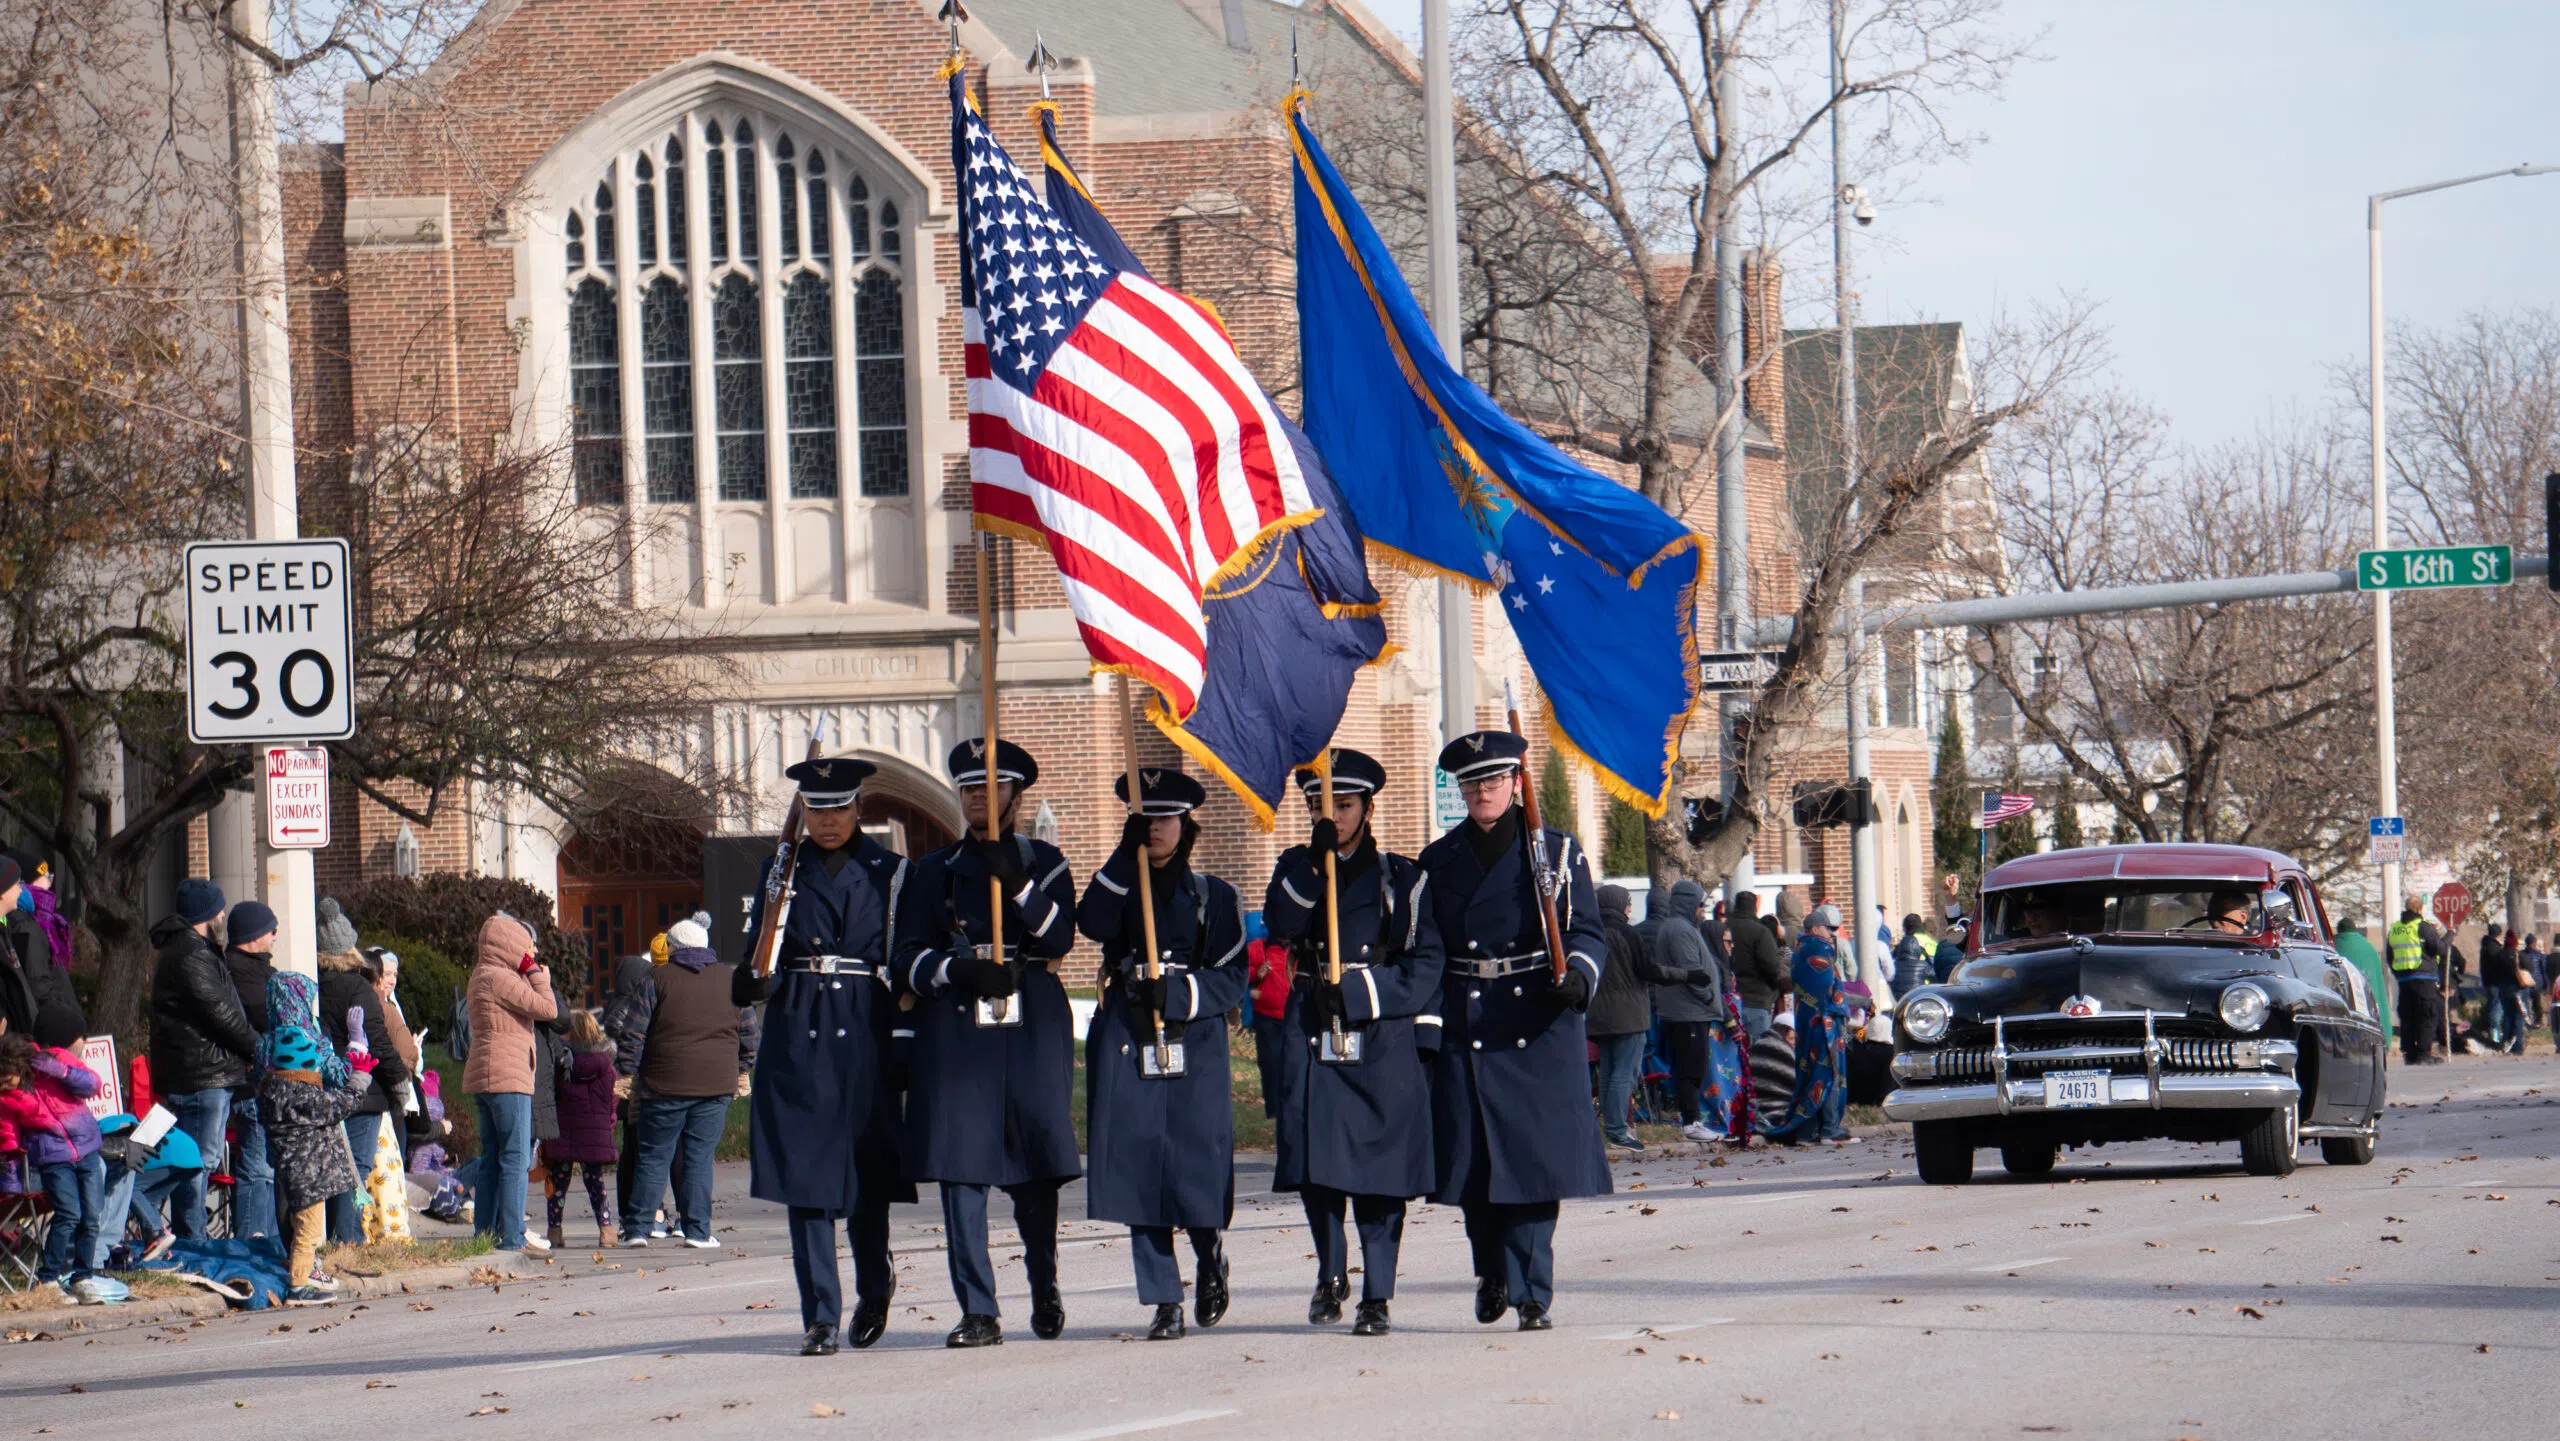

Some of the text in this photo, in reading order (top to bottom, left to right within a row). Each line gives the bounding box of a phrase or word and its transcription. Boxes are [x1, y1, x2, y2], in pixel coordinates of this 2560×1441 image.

[201, 561, 333, 593] SPEED
[2369, 551, 2500, 586] S 16th St
[217, 603, 319, 634] LIMIT
[814, 655, 919, 677] CHURCH
[1720, 664, 1754, 679] WAY
[208, 648, 335, 720] 30
[270, 754, 323, 774] NO PARKING
[277, 783, 319, 798] EXCEPT
[275, 804, 322, 819] SUNDAYS
[2374, 851, 2401, 861] ROUTE
[2375, 842, 2400, 851] SNOW
[2433, 895, 2470, 914] STOP
[2059, 1082, 2097, 1099] 24673
